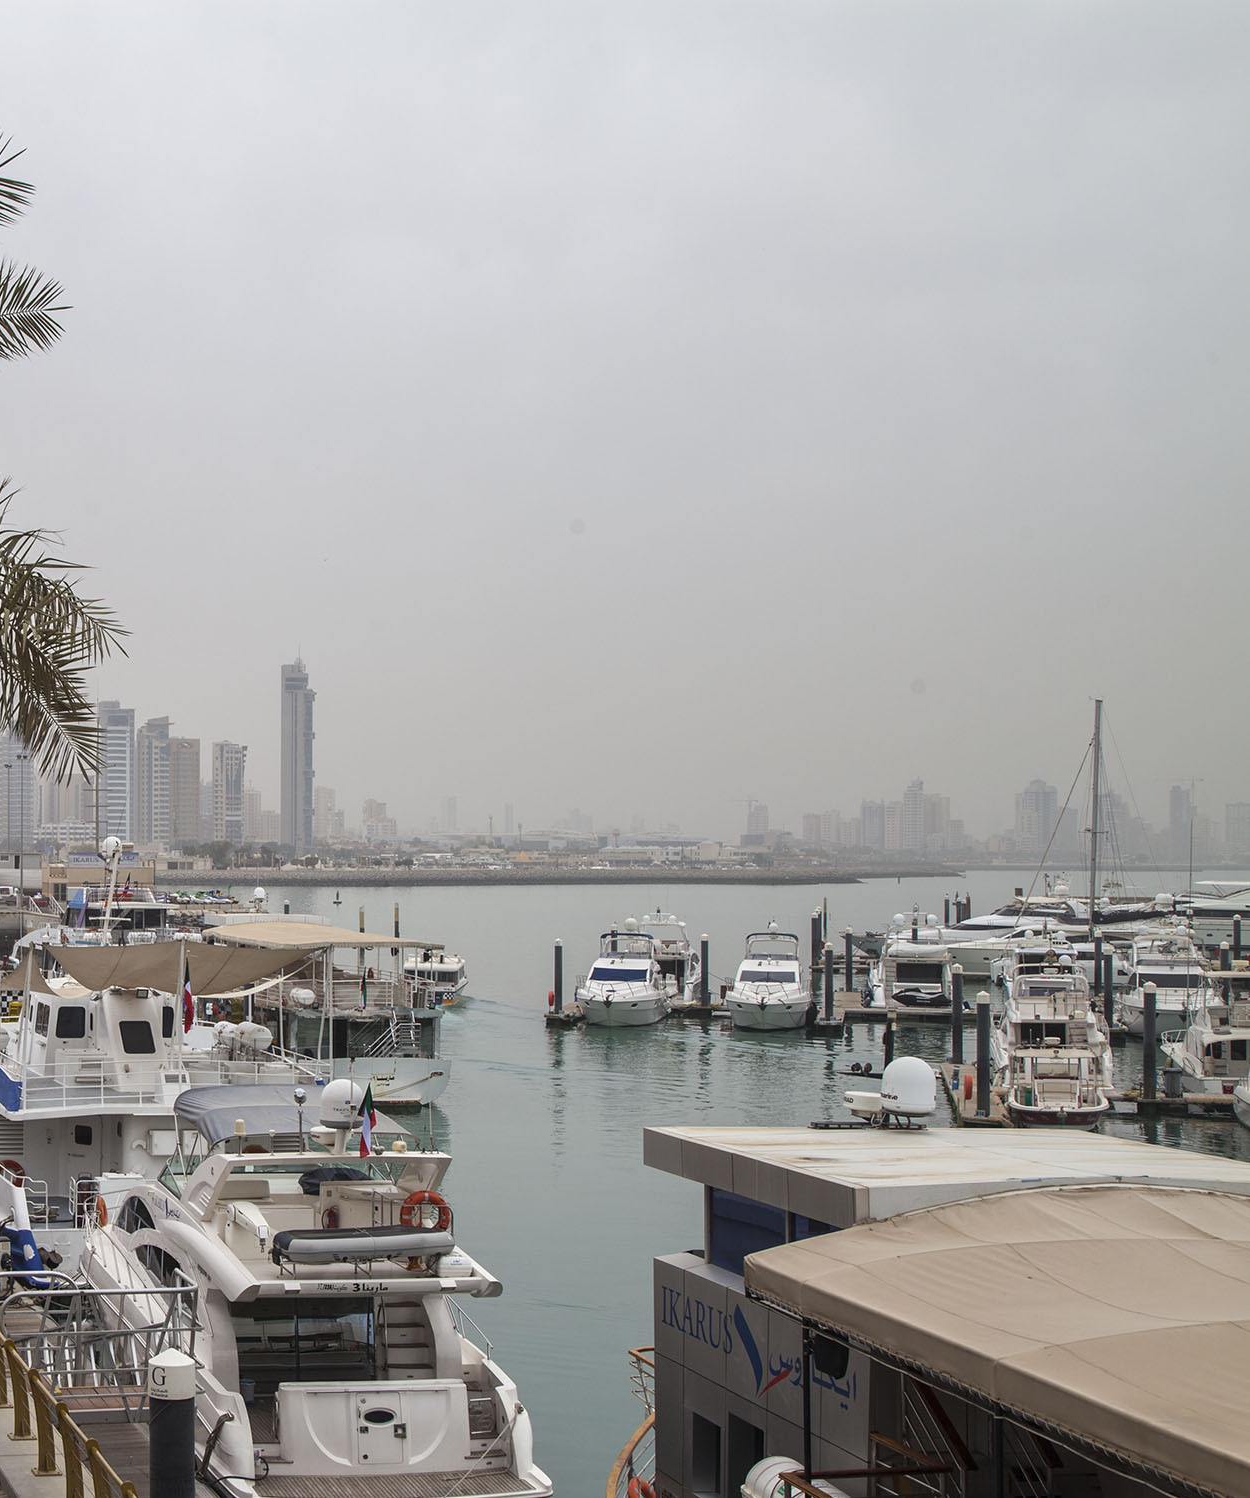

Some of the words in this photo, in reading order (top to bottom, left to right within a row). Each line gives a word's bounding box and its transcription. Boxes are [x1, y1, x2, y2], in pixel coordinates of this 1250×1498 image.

[352, 1283, 361, 1292] 3
[362, 1282, 389, 1295] مارينا
[662, 1285, 733, 1354] IKARUS
[152, 1366, 166, 1386] G
